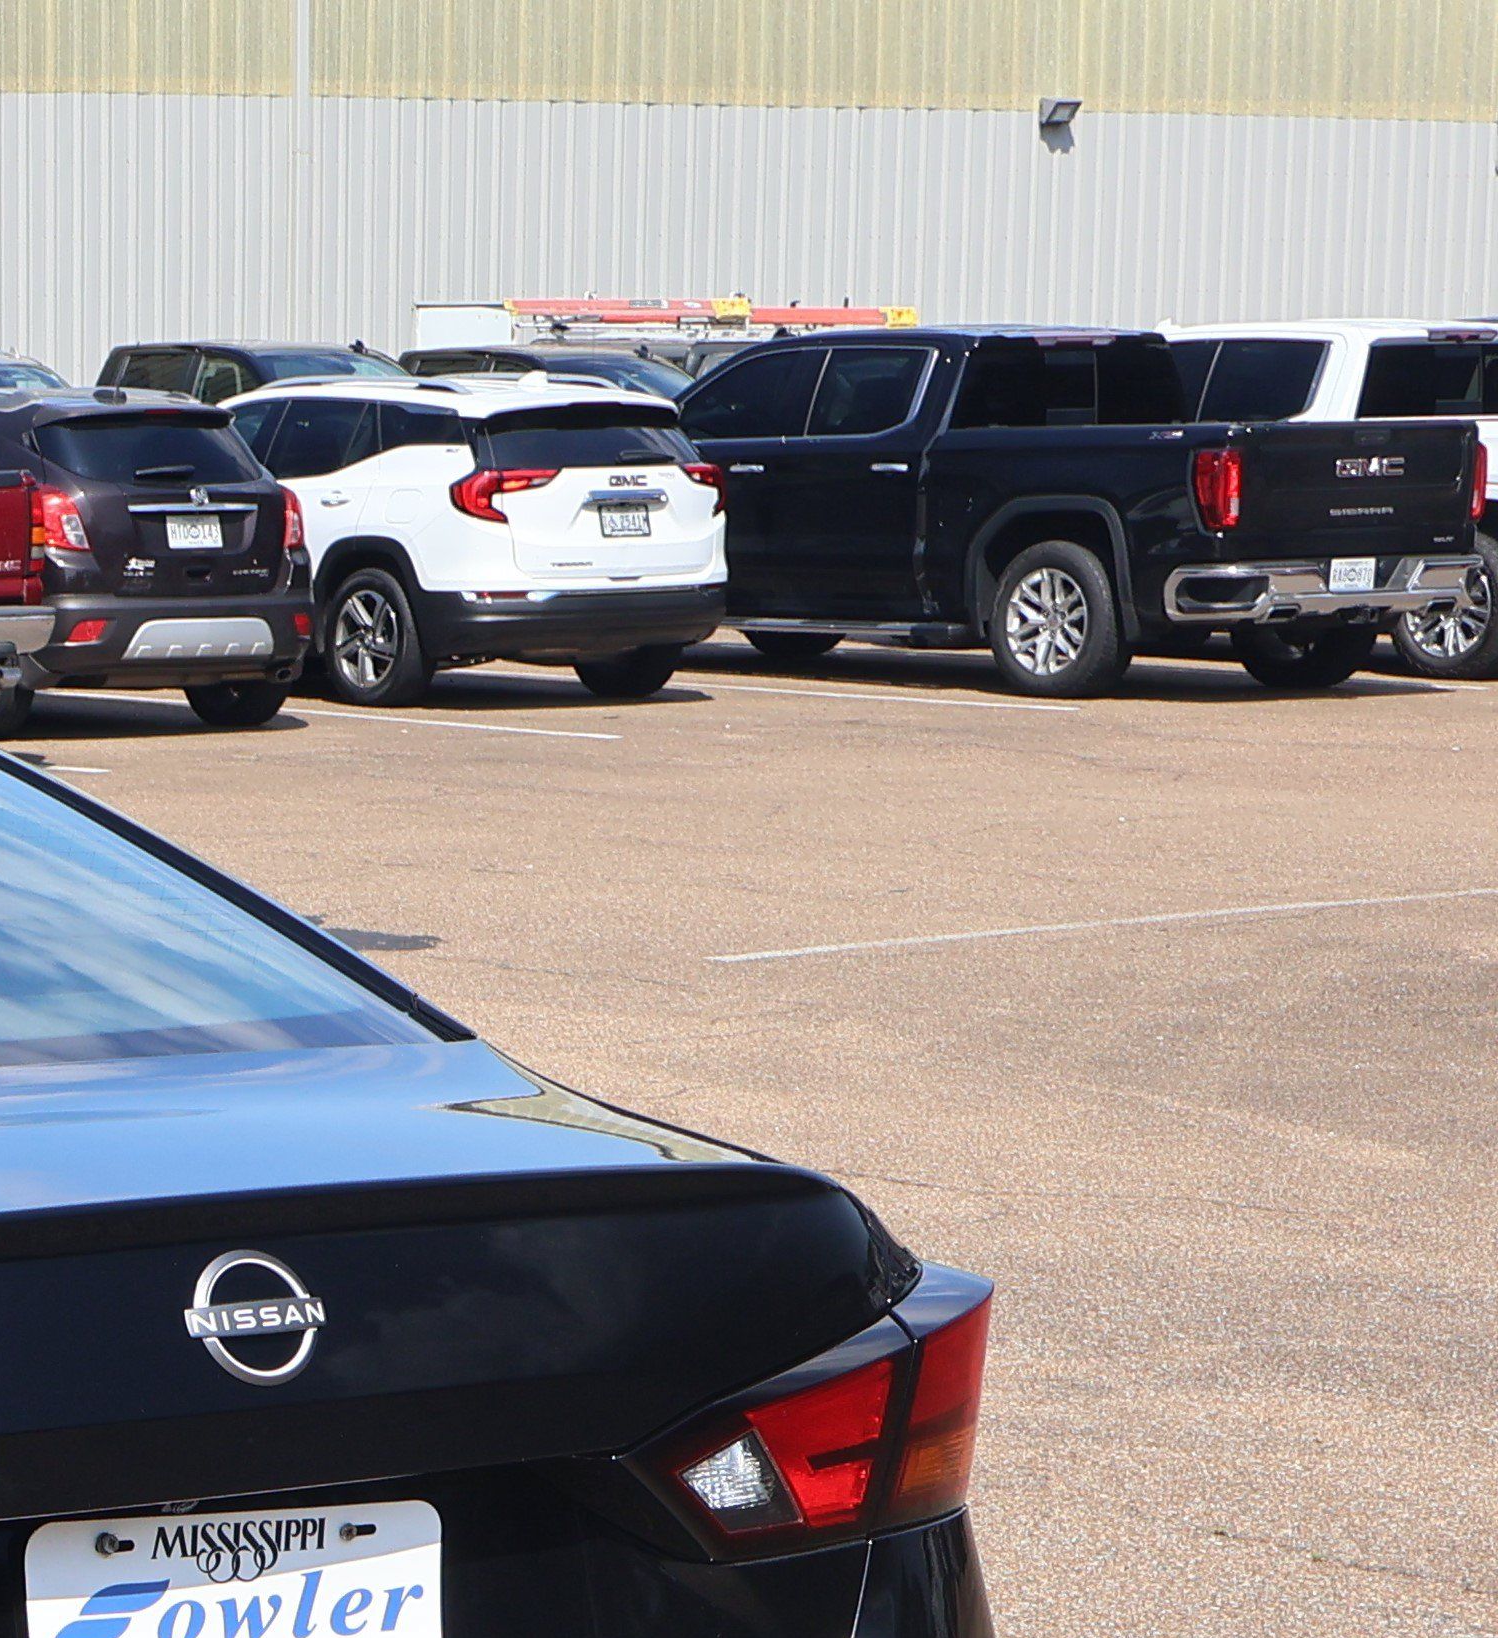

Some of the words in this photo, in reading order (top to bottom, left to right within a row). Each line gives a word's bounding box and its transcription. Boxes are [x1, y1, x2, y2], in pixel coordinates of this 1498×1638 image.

[1335, 457, 1404, 477] GMC
[609, 474, 648, 487] GMC
[190, 1302, 326, 1333] NISSAN
[151, 1517, 327, 1583] MISSISSIPPI
